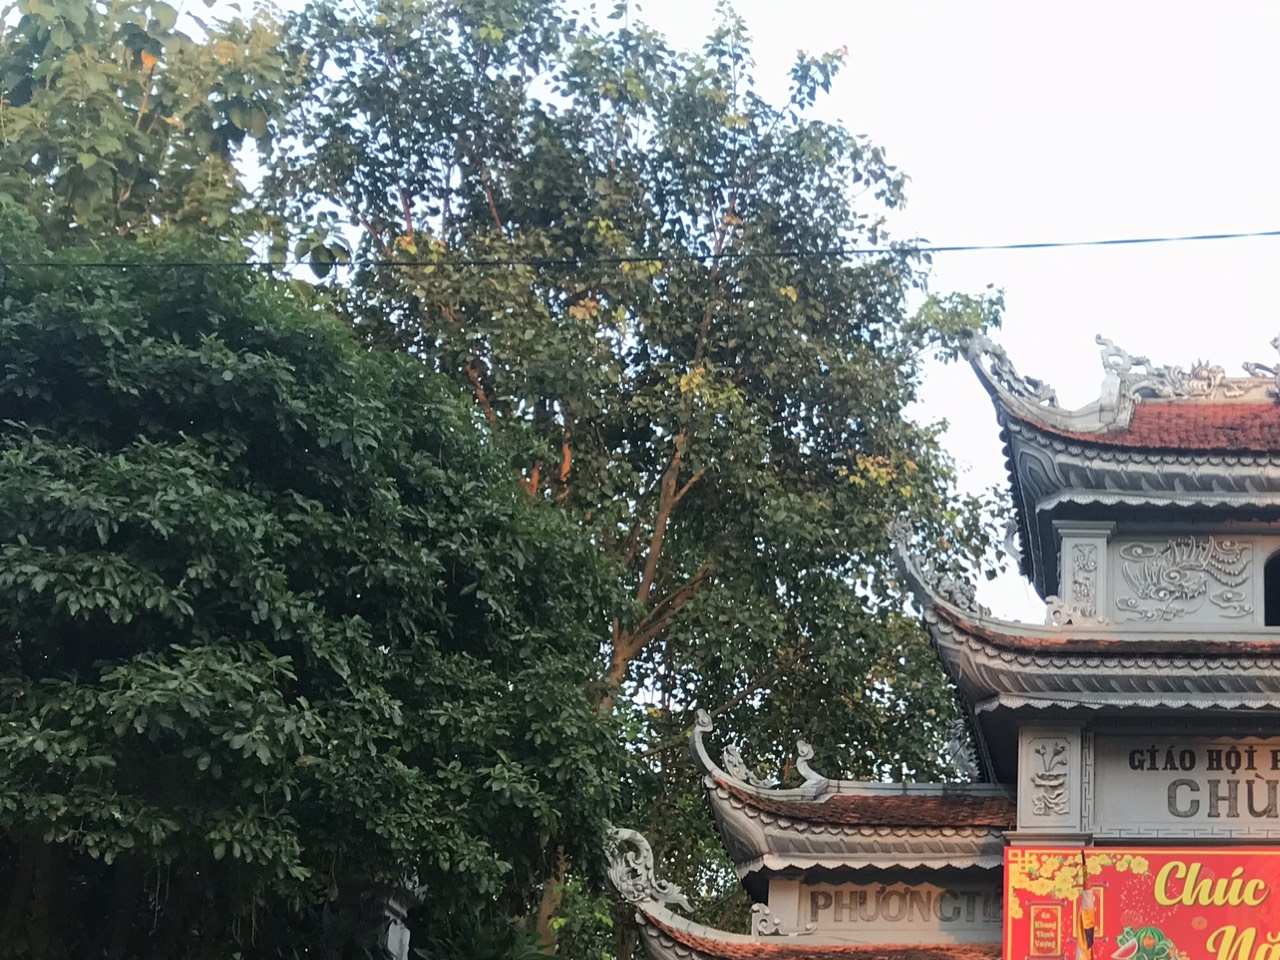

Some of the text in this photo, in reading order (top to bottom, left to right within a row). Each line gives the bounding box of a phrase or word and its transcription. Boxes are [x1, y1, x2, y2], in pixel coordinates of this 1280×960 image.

[1128, 745, 1196, 771] GIÁO
[1206, 746, 1258, 775] HỘI
[1154, 860, 1270, 906] Chúc
[810, 886, 961, 922] PHƯƠNG
